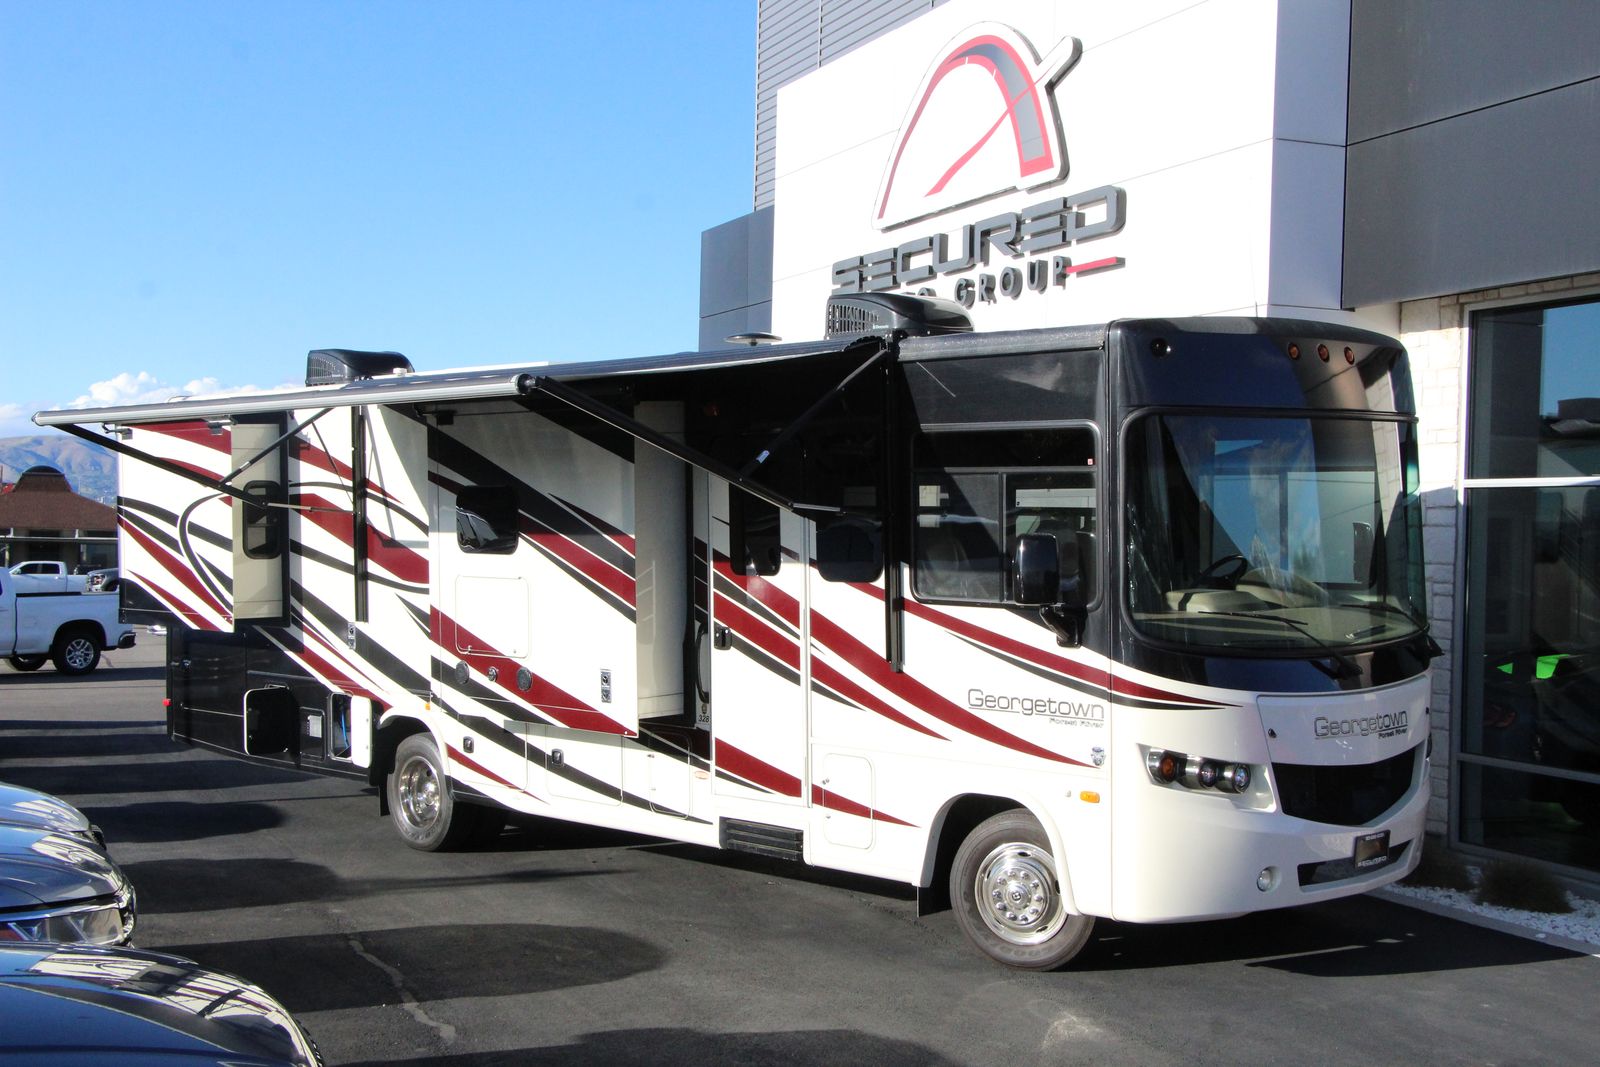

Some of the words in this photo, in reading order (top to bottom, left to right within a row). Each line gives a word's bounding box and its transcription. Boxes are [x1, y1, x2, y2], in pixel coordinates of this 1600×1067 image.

[831, 184, 1126, 293] SECURED
[954, 255, 1071, 309] GROUP
[967, 688, 1104, 718] Georgetown
[1314, 710, 1408, 736] Georgetown
